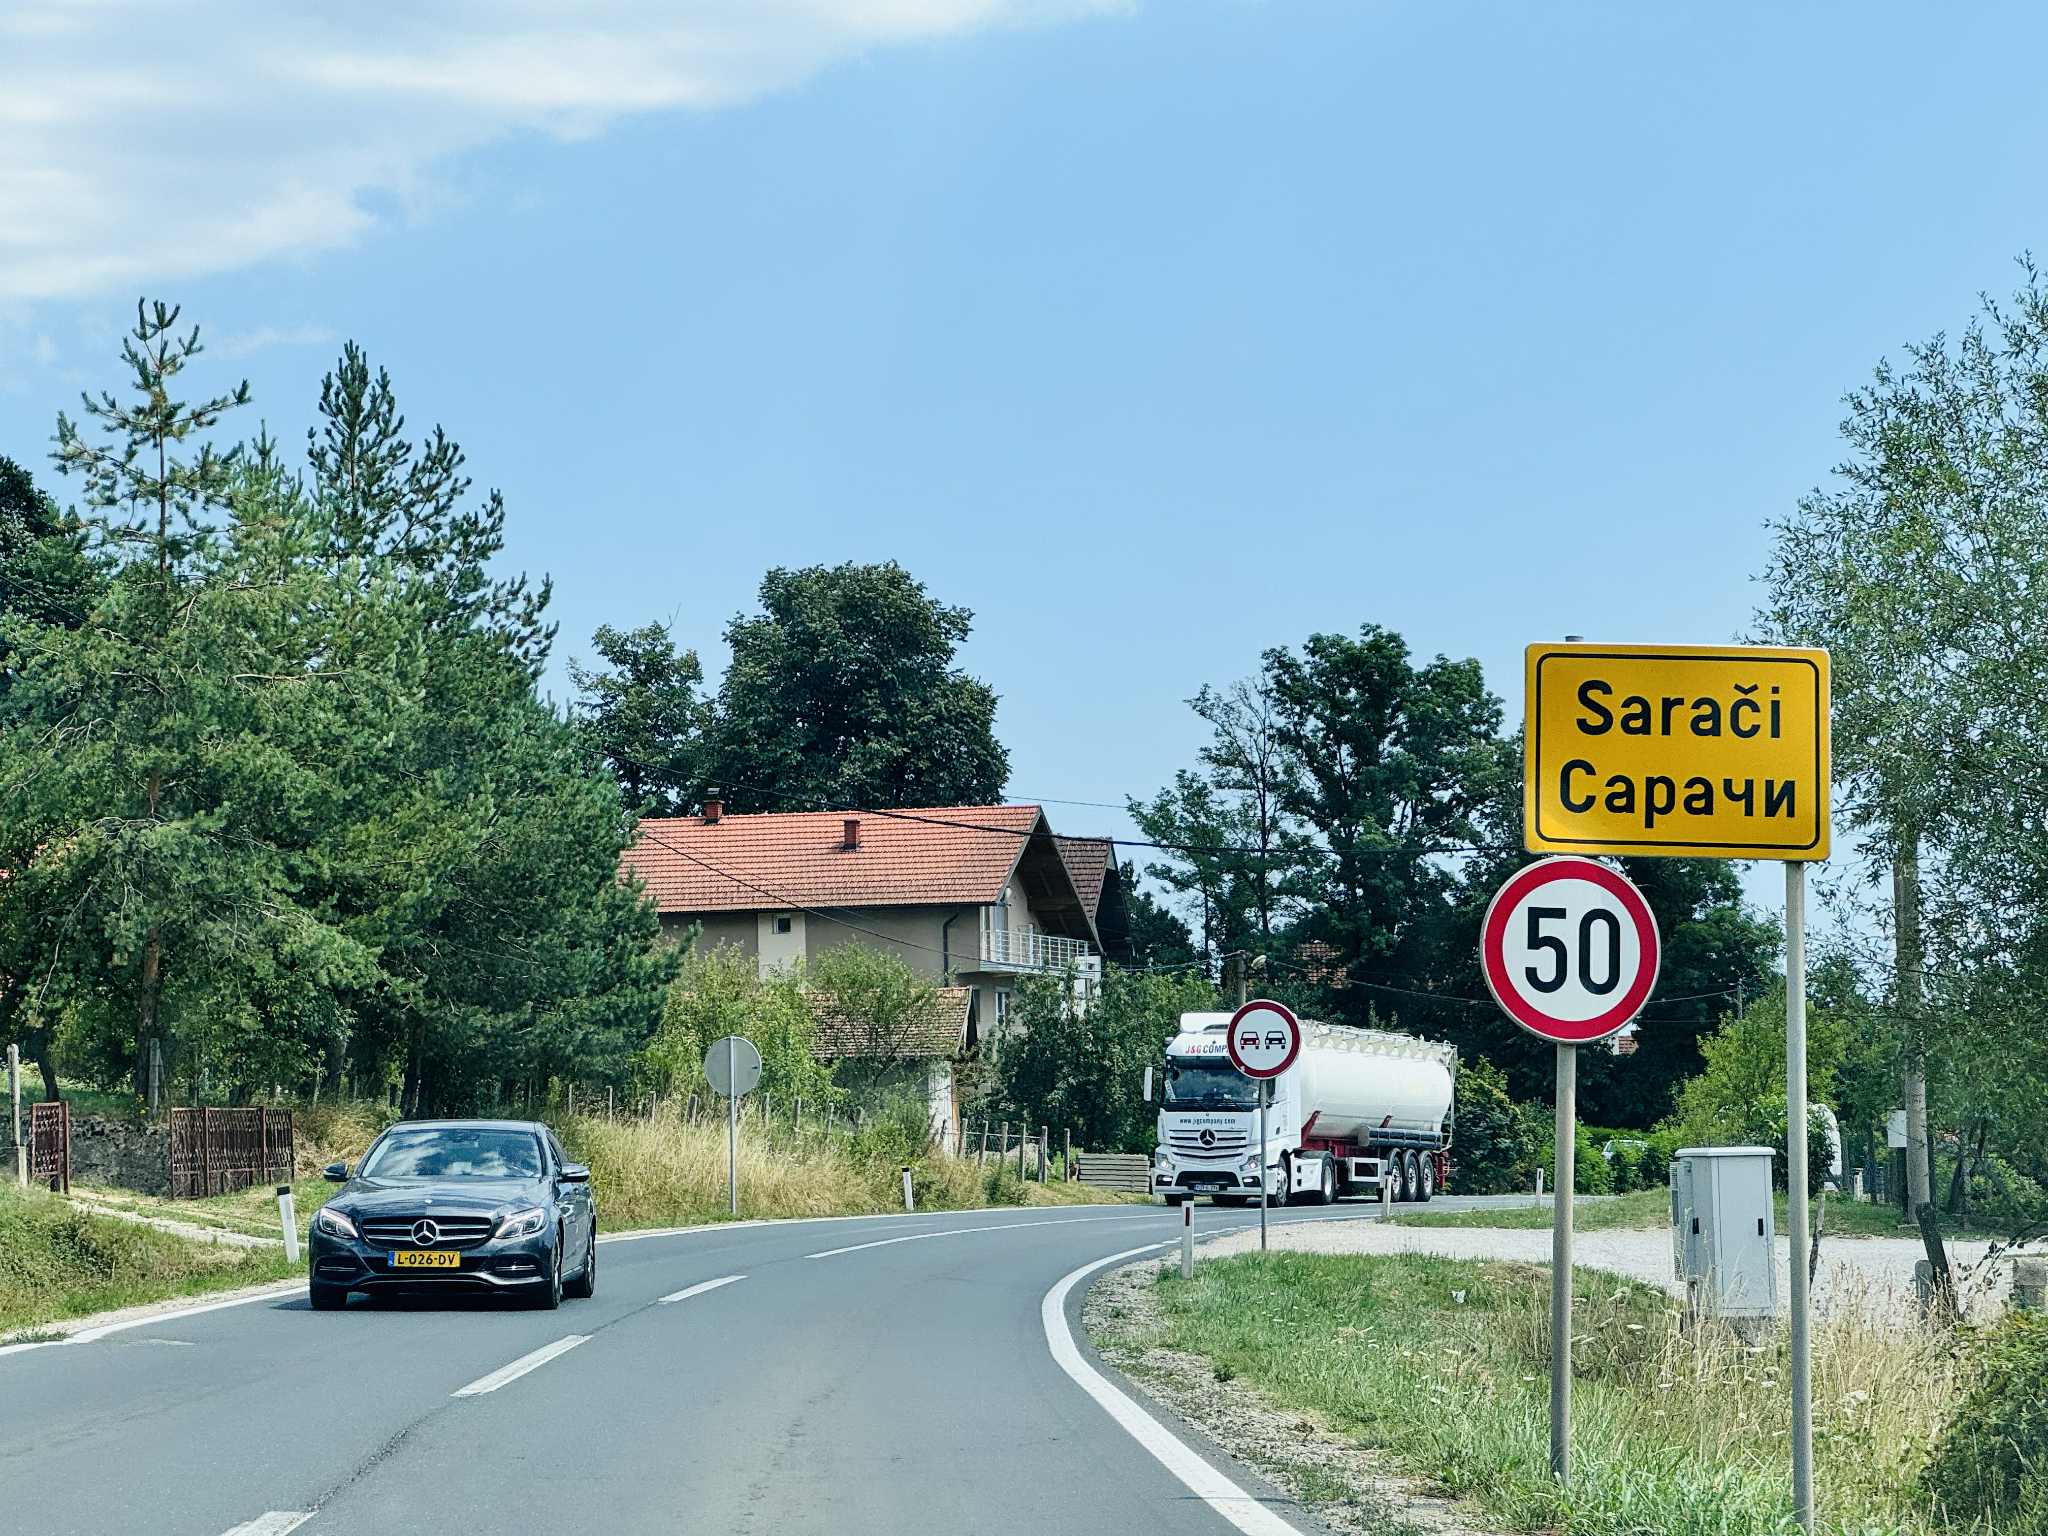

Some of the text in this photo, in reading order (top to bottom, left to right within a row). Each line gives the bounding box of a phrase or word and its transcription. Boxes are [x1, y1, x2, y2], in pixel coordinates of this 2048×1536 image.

[1576, 680, 1781, 738] Sarači
[1560, 759, 1796, 828] Сарачи
[1525, 906, 1621, 995] 50
[397, 1253, 456, 1265] L-026-DV
